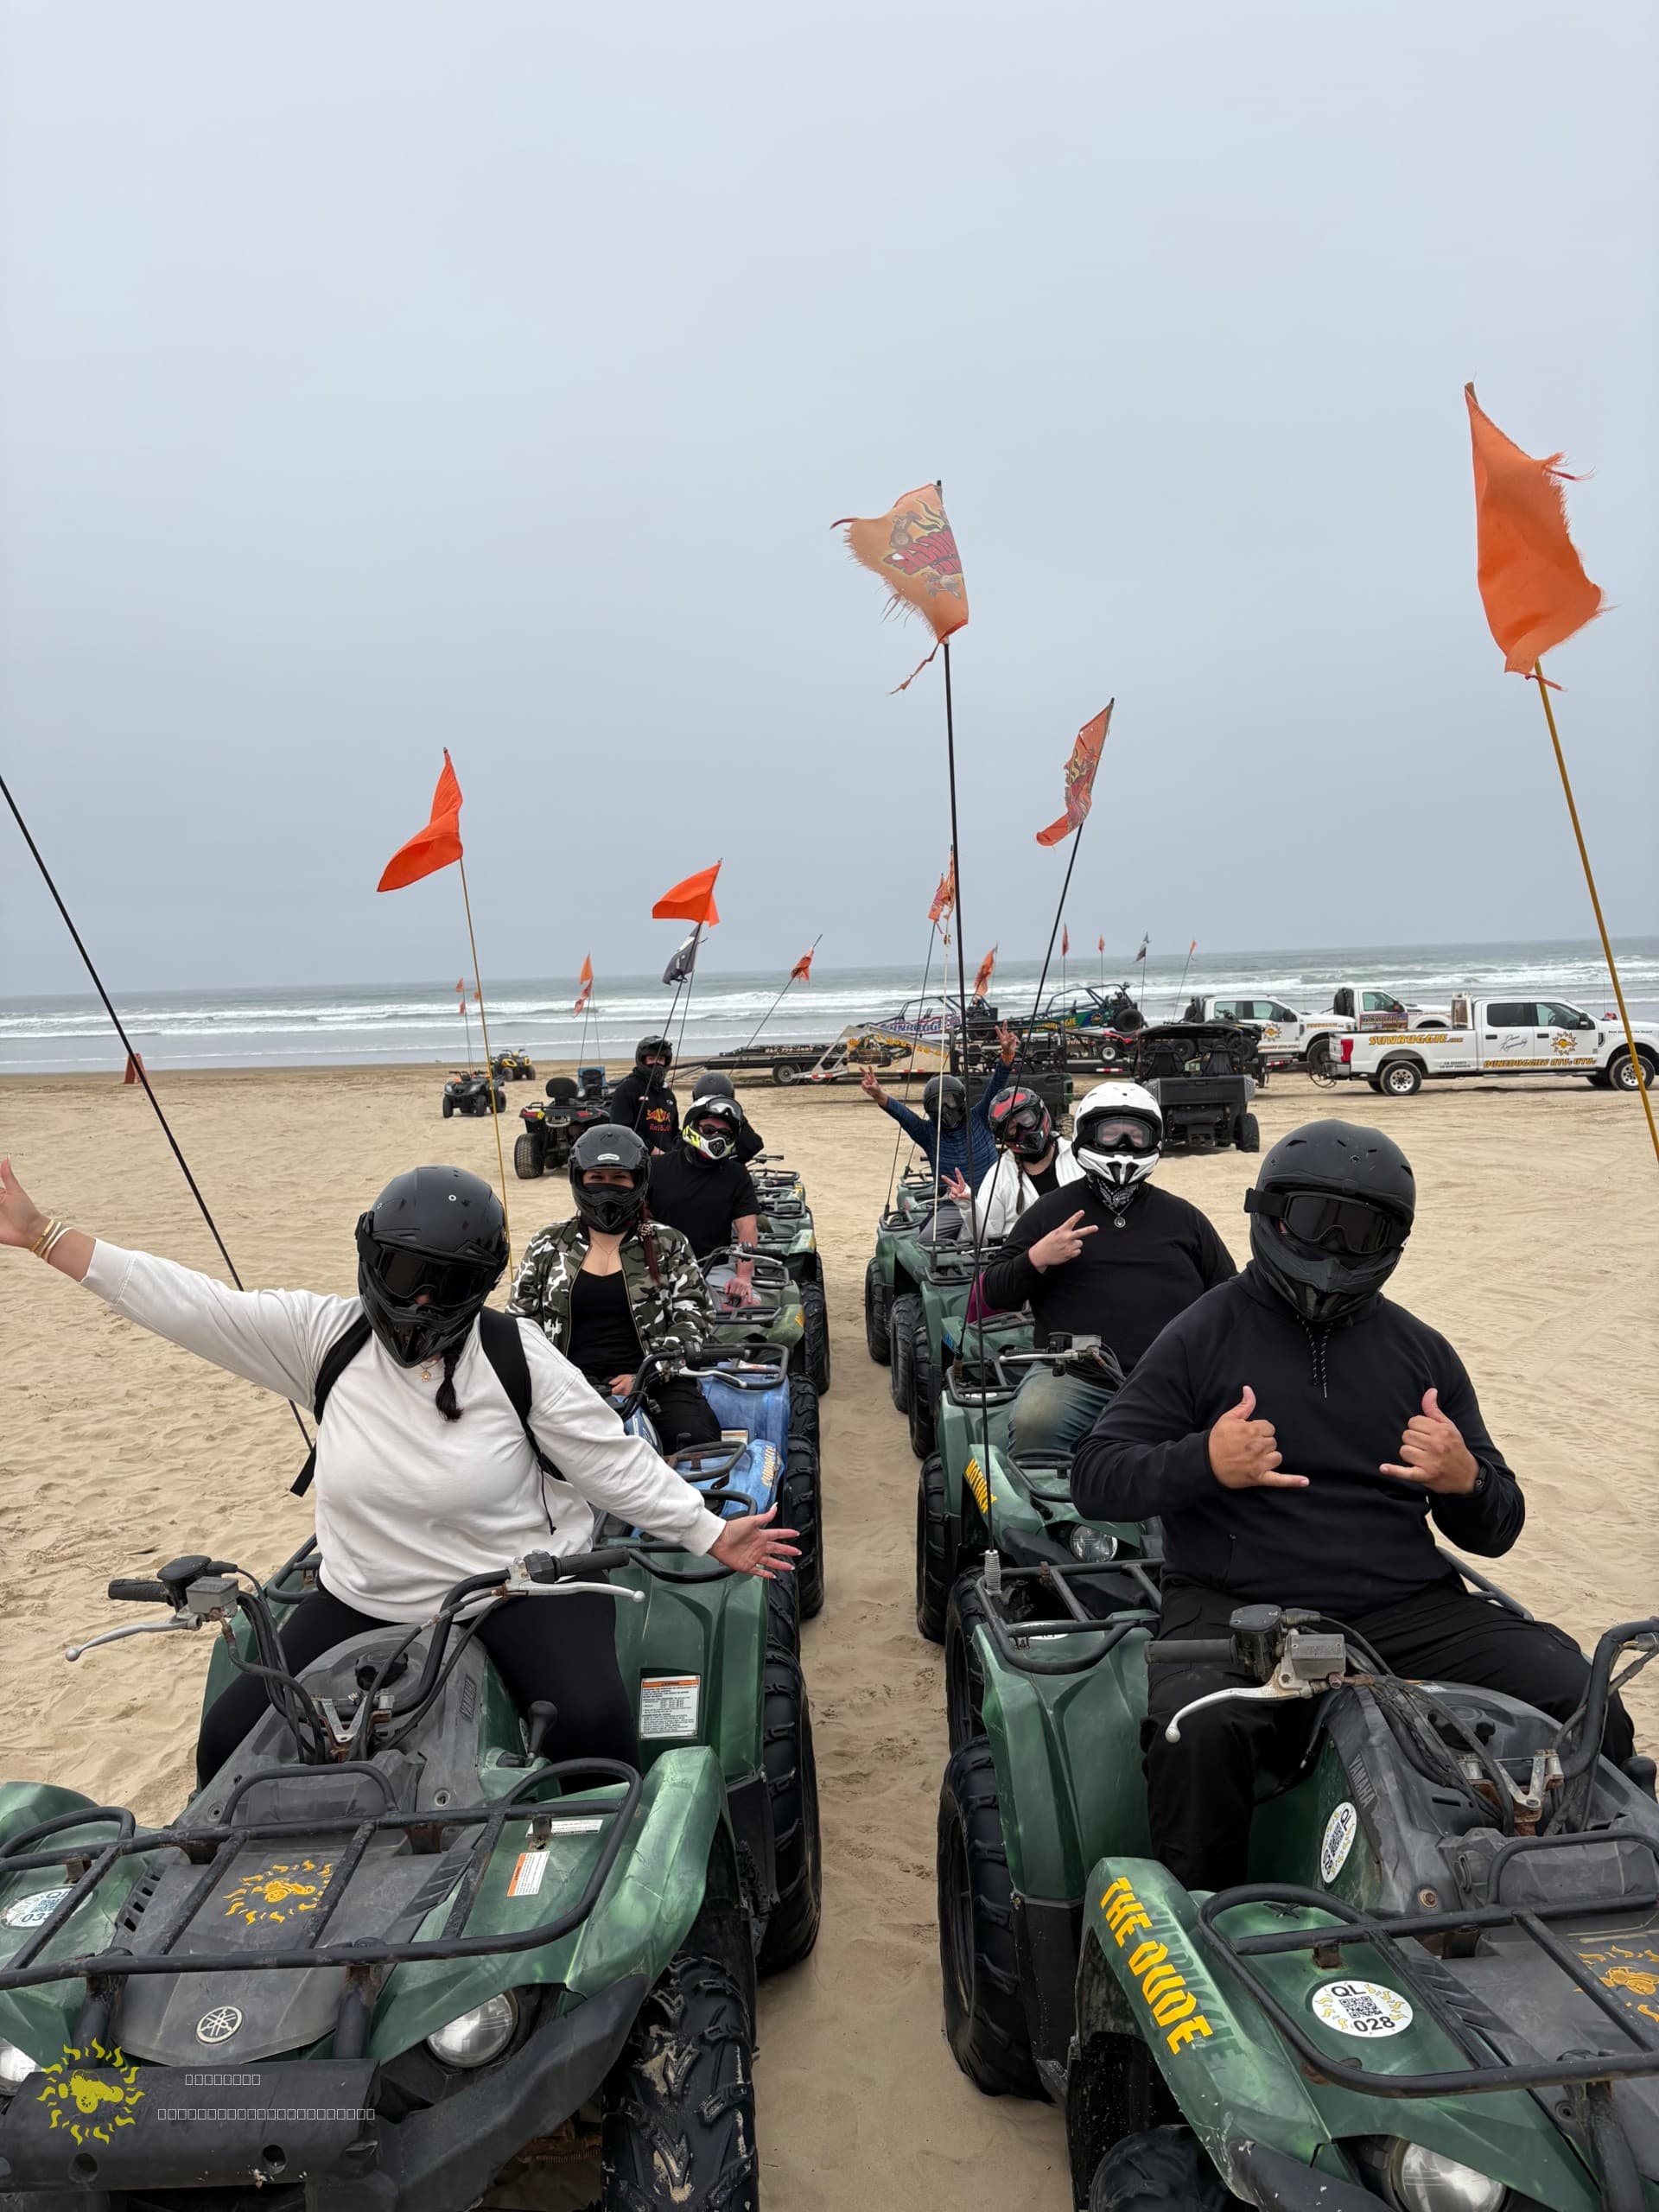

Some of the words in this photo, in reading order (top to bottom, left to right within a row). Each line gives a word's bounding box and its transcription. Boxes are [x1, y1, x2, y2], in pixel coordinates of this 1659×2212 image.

[1349, 1753, 1376, 1808] YAMAHA
[22, 1912, 50, 1923] 03
[1100, 1876, 1153, 1948] THE
[1128, 1940, 1214, 2055] DUDE
[1331, 1984, 1367, 1999] QL
[1353, 2016, 1395, 2032] 028
